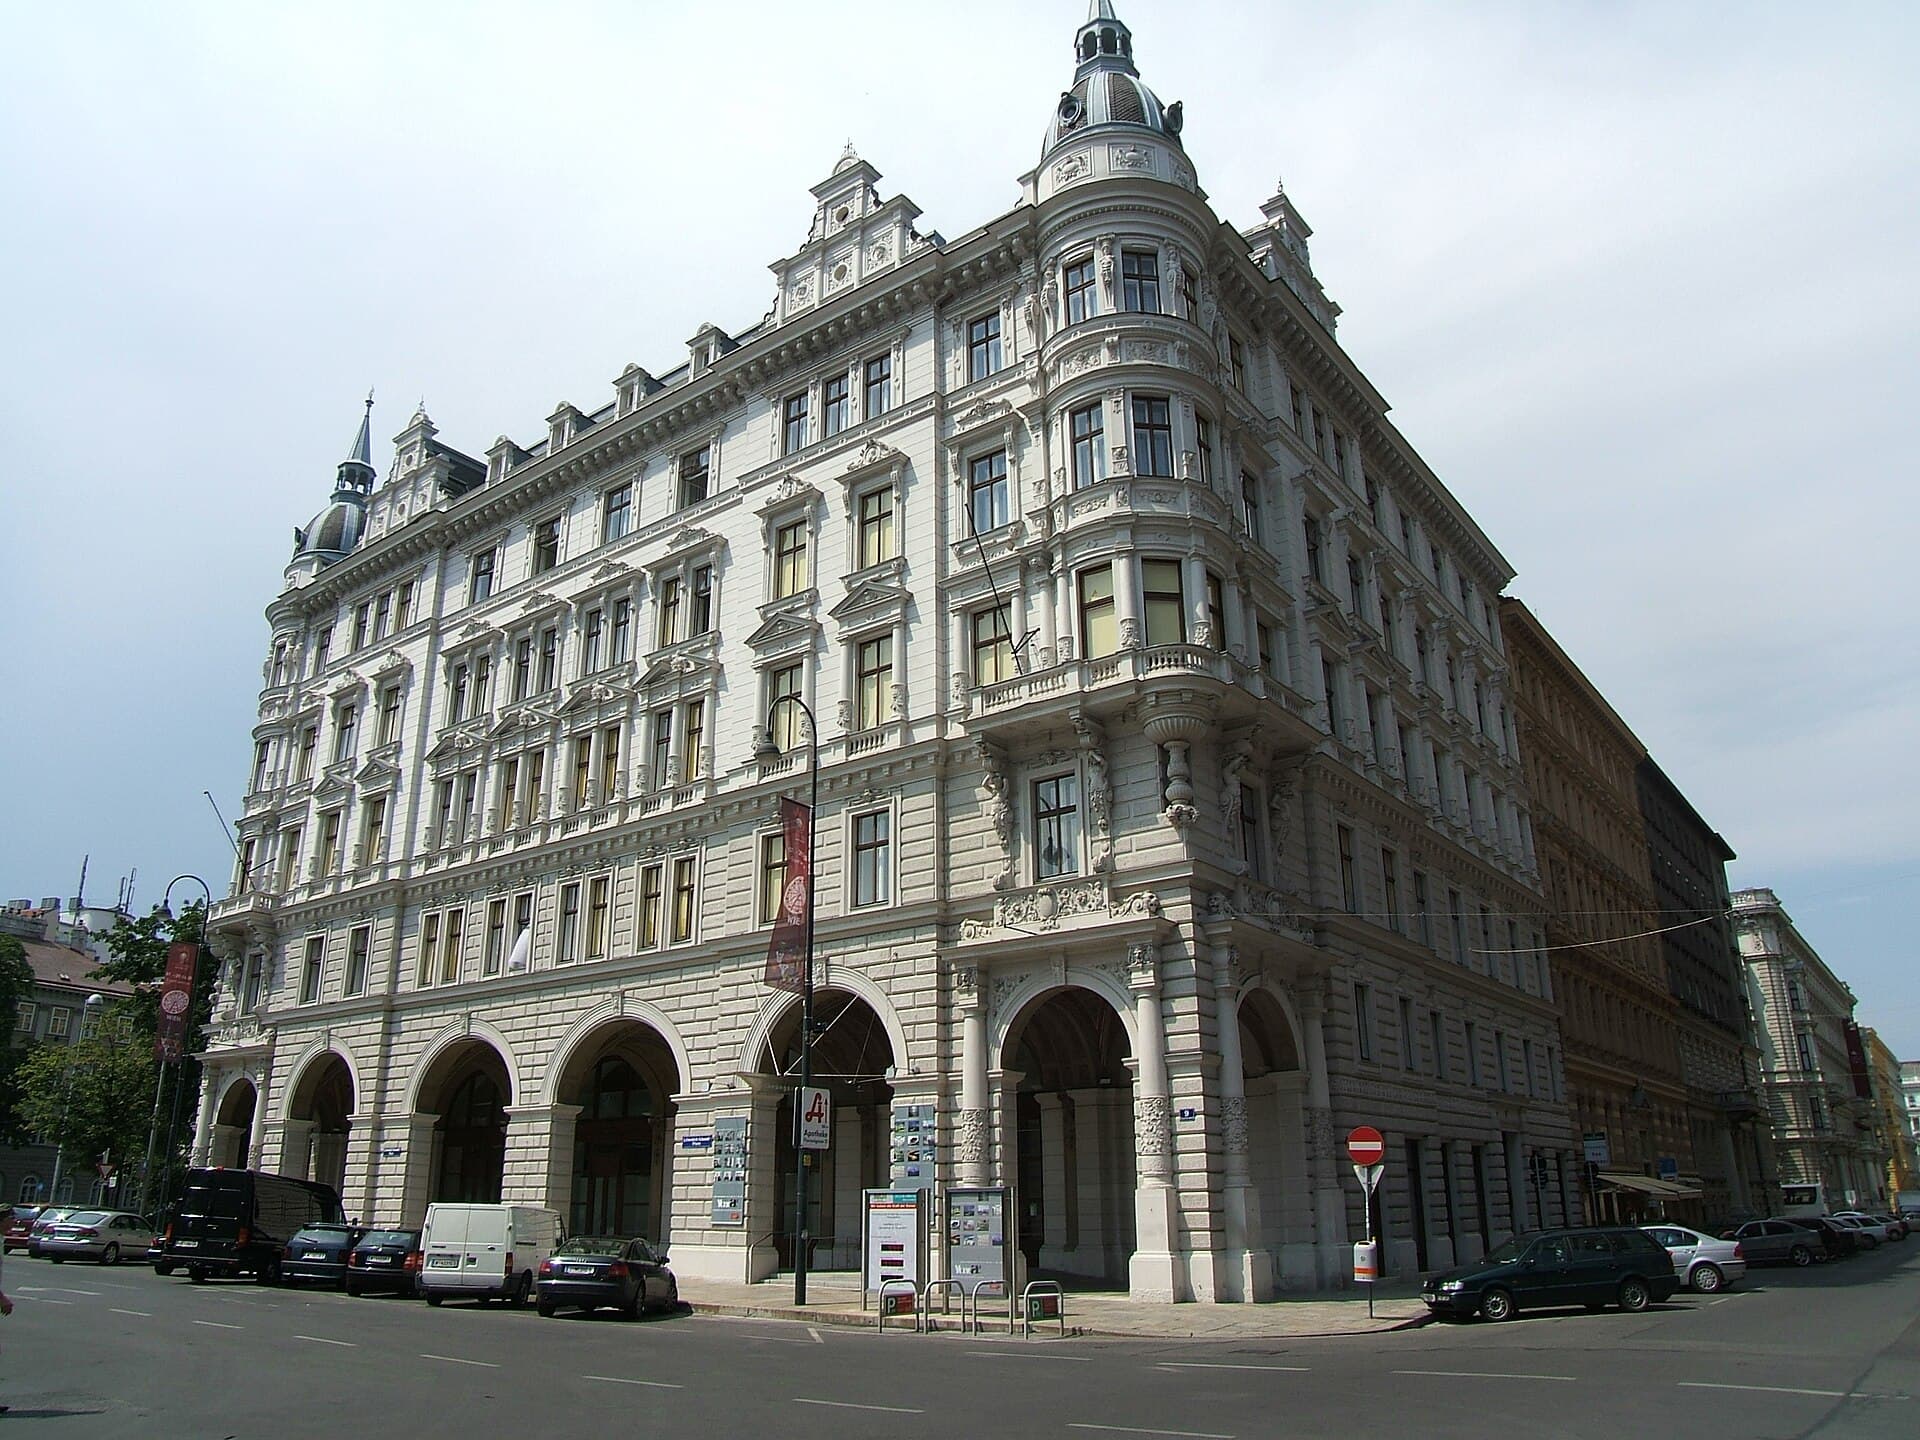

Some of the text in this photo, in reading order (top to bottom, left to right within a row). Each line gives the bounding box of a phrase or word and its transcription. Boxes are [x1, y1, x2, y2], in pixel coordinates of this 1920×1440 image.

[787, 914, 801, 926] WIE
[803, 1129, 828, 1138] Apotheke
[887, 1297, 896, 1314] P
[1032, 1300, 1040, 1318] P
